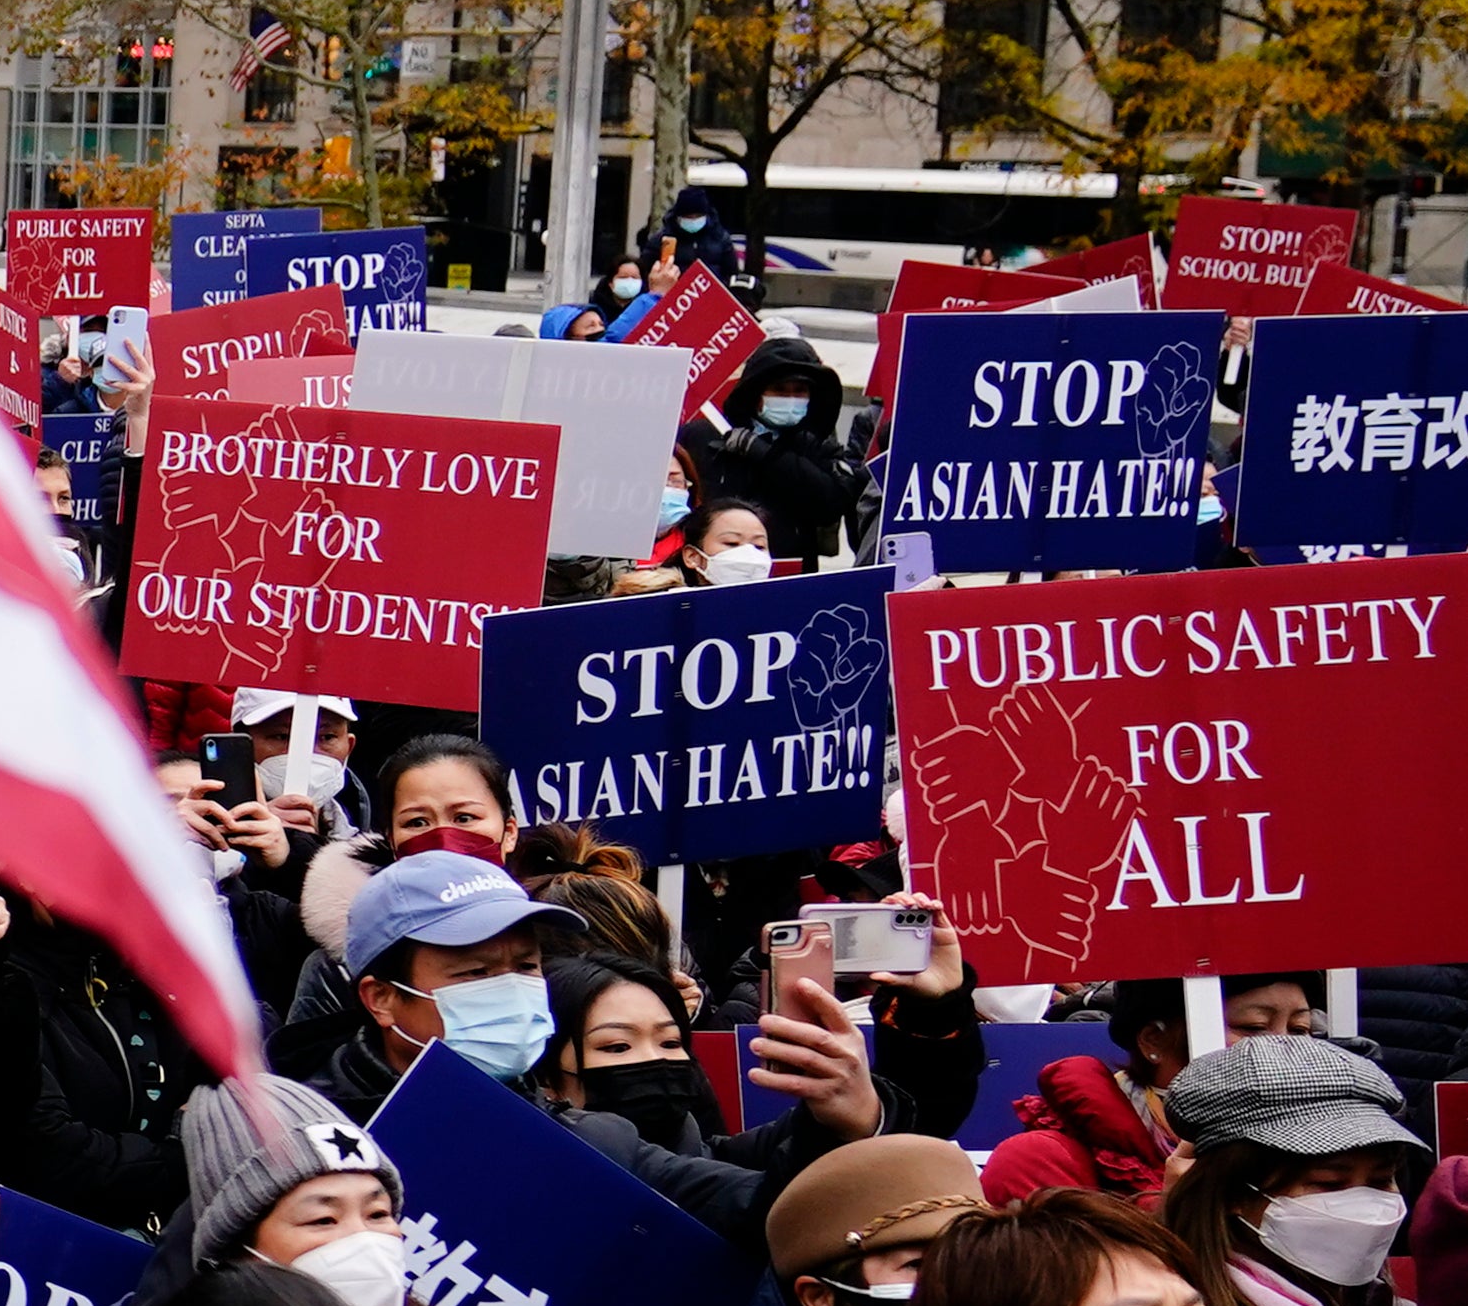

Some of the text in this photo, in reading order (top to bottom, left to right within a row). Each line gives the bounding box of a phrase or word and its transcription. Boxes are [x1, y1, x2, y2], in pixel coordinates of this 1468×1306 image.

[15, 217, 145, 239] PUBLIC SAFETY
[194, 235, 247, 258] CLEA
[225, 214, 266, 229] SEPTA
[1219, 224, 1302, 256] STOP!!
[62, 248, 97, 267] FOR
[288, 251, 386, 293] STOP
[1178, 255, 1307, 289] SCHOOL BUL
[53, 273, 105, 300] ALL
[666, 272, 713, 323] LOVE
[181, 329, 284, 380] STOP!!
[968, 360, 1145, 429] STOP
[158, 430, 540, 500] BROTHERLY LOVE
[894, 456, 1196, 523] ASIAN HATE!!
[289, 510, 383, 564] FOR
[137, 572, 236, 624] OUR
[925, 595, 1446, 691] PUBLIC SAFETY
[576, 629, 799, 726] STOP
[505, 725, 874, 831] ASIAN HATE!!
[1123, 719, 1262, 788] FOR
[1105, 811, 1306, 913] ALL
